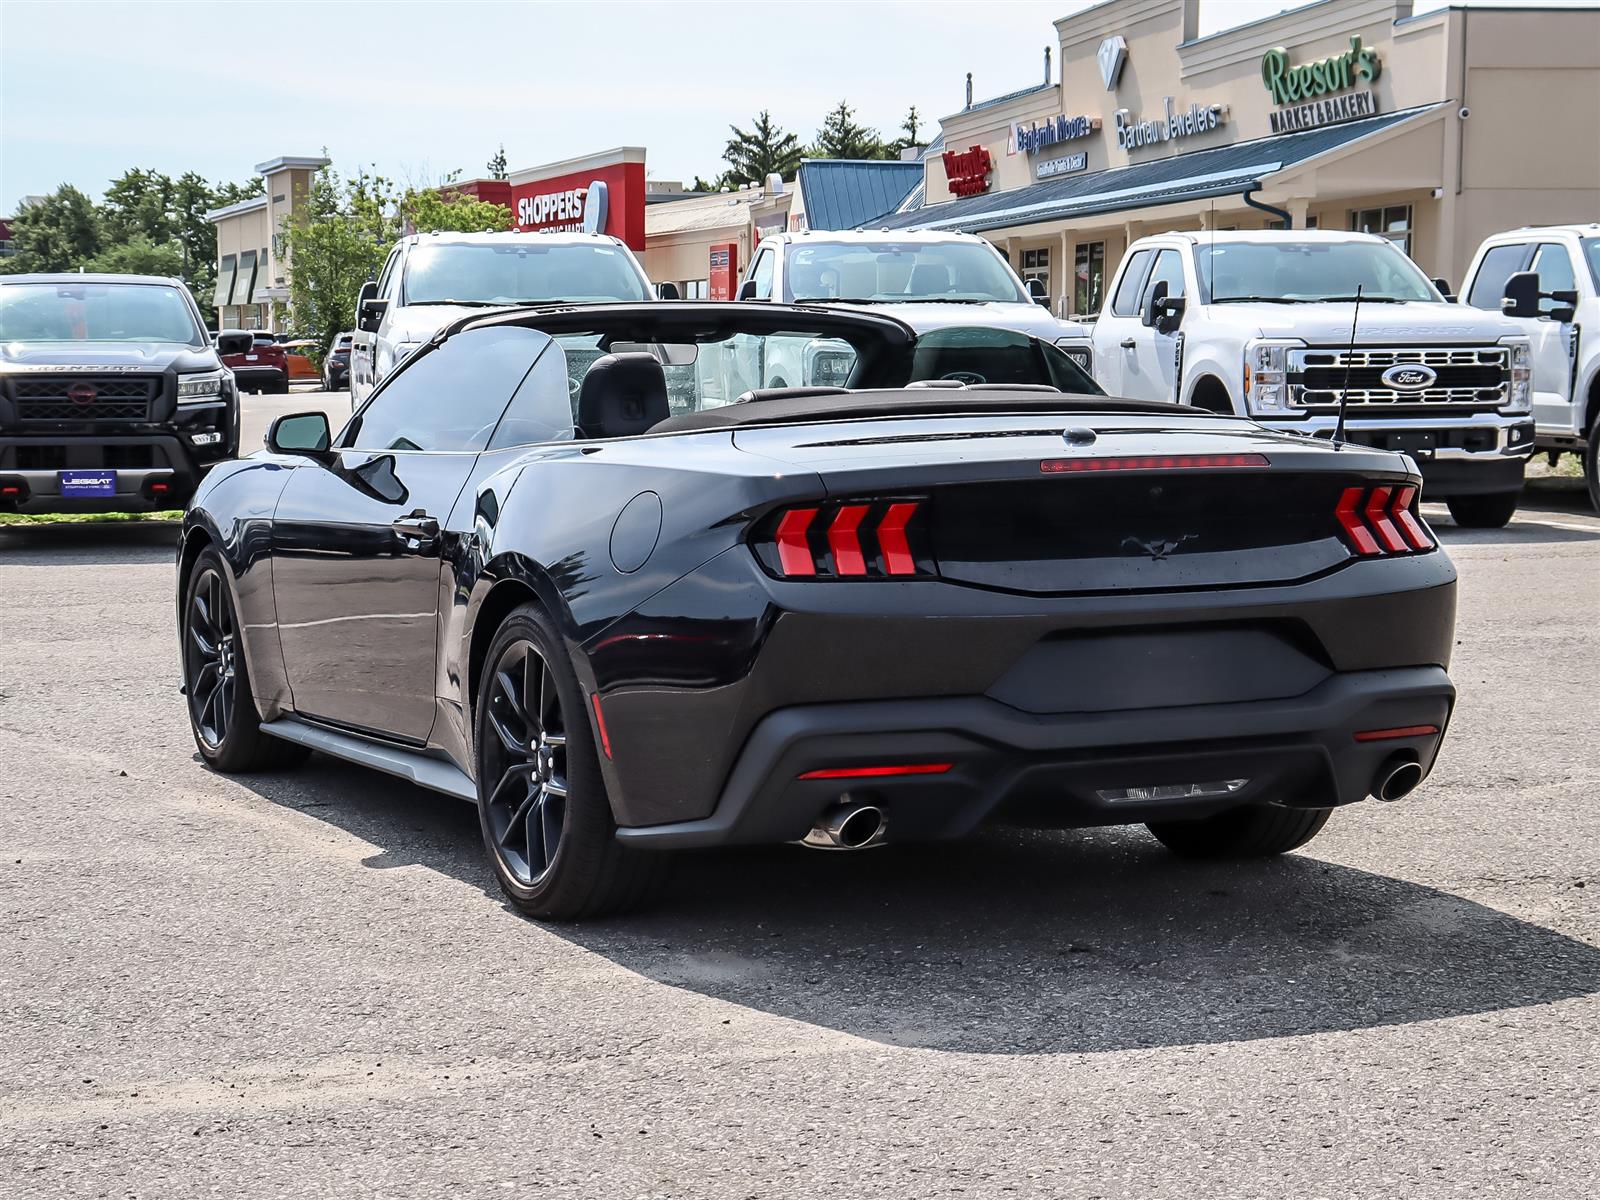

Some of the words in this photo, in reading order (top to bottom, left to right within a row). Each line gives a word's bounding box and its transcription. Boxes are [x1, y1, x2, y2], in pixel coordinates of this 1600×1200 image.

[1262, 34, 1381, 105] Reesor's
[1016, 118, 1056, 155] Benjamin
[1057, 114, 1088, 141] Moore
[1162, 96, 1217, 141] Jewellers
[518, 188, 583, 226] SHOPPERS
[1397, 371, 1424, 383] Ford
